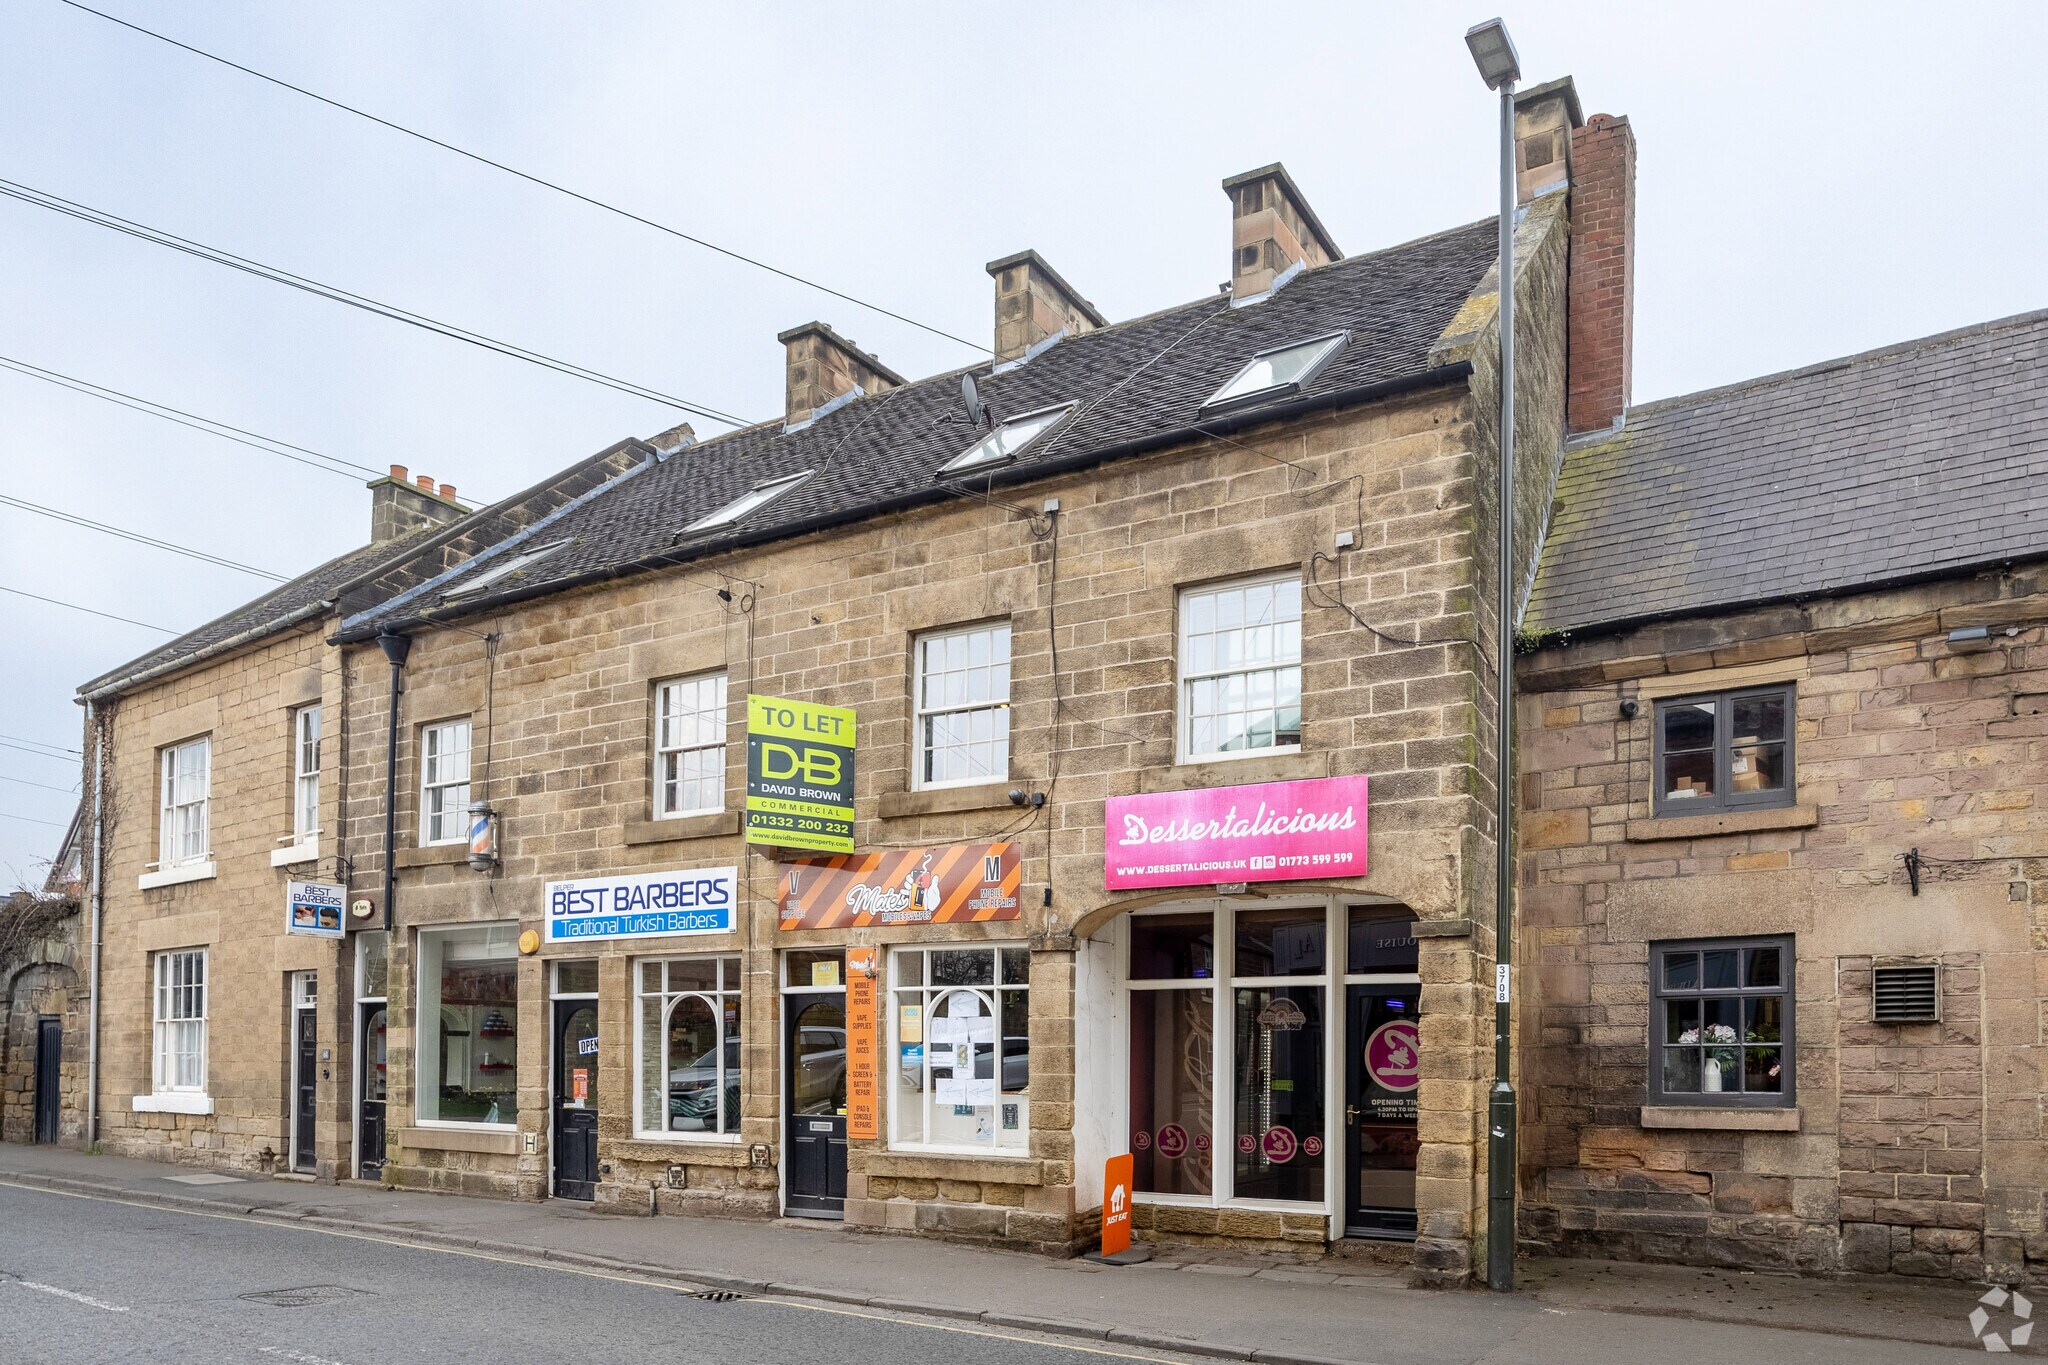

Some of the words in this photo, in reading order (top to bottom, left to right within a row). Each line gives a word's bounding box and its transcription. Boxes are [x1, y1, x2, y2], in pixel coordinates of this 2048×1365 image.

[762, 706, 795, 728] TO
[803, 713, 844, 735] LET
[761, 783, 796, 796] DAVID
[800, 787, 841, 802] BROWN
[761, 801, 841, 816] COMMERCIAL
[751, 814, 794, 828] 01332
[798, 819, 822, 830] 200
[826, 823, 849, 834] 232
[1119, 801, 1356, 846] Dessertalicious
[751, 832, 849, 848] www.davidbrownproperty.com
[985, 855, 1000, 882] M
[1117, 859, 1247, 876] WWW.DESSERTALICIOUS.UK
[1279, 854, 1310, 867] 01773
[1312, 853, 1331, 866] 599
[1333, 852, 1353, 864] 599
[789, 870, 800, 895] V
[305, 886, 331, 896] BEST
[552, 888, 609, 916] BEST
[614, 878, 728, 911] BARBERS
[981, 888, 1004, 898] MOBILE
[294, 894, 341, 905] BARBERS
[969, 899, 988, 909] PHONE
[990, 897, 1016, 908] REPAIRS
[561, 919, 619, 936] Traditional
[622, 915, 664, 932] Turkish
[668, 912, 718, 929] Barbers
[852, 1022, 872, 1030] SUPPLIES
[581, 1039, 598, 1053] OPEN
[852, 1070, 869, 1078] SCREEN
[854, 1121, 872, 1129] REPAIRS
[1106, 1214, 1119, 1226] JUST
[1118, 1211, 1128, 1222] EAT
